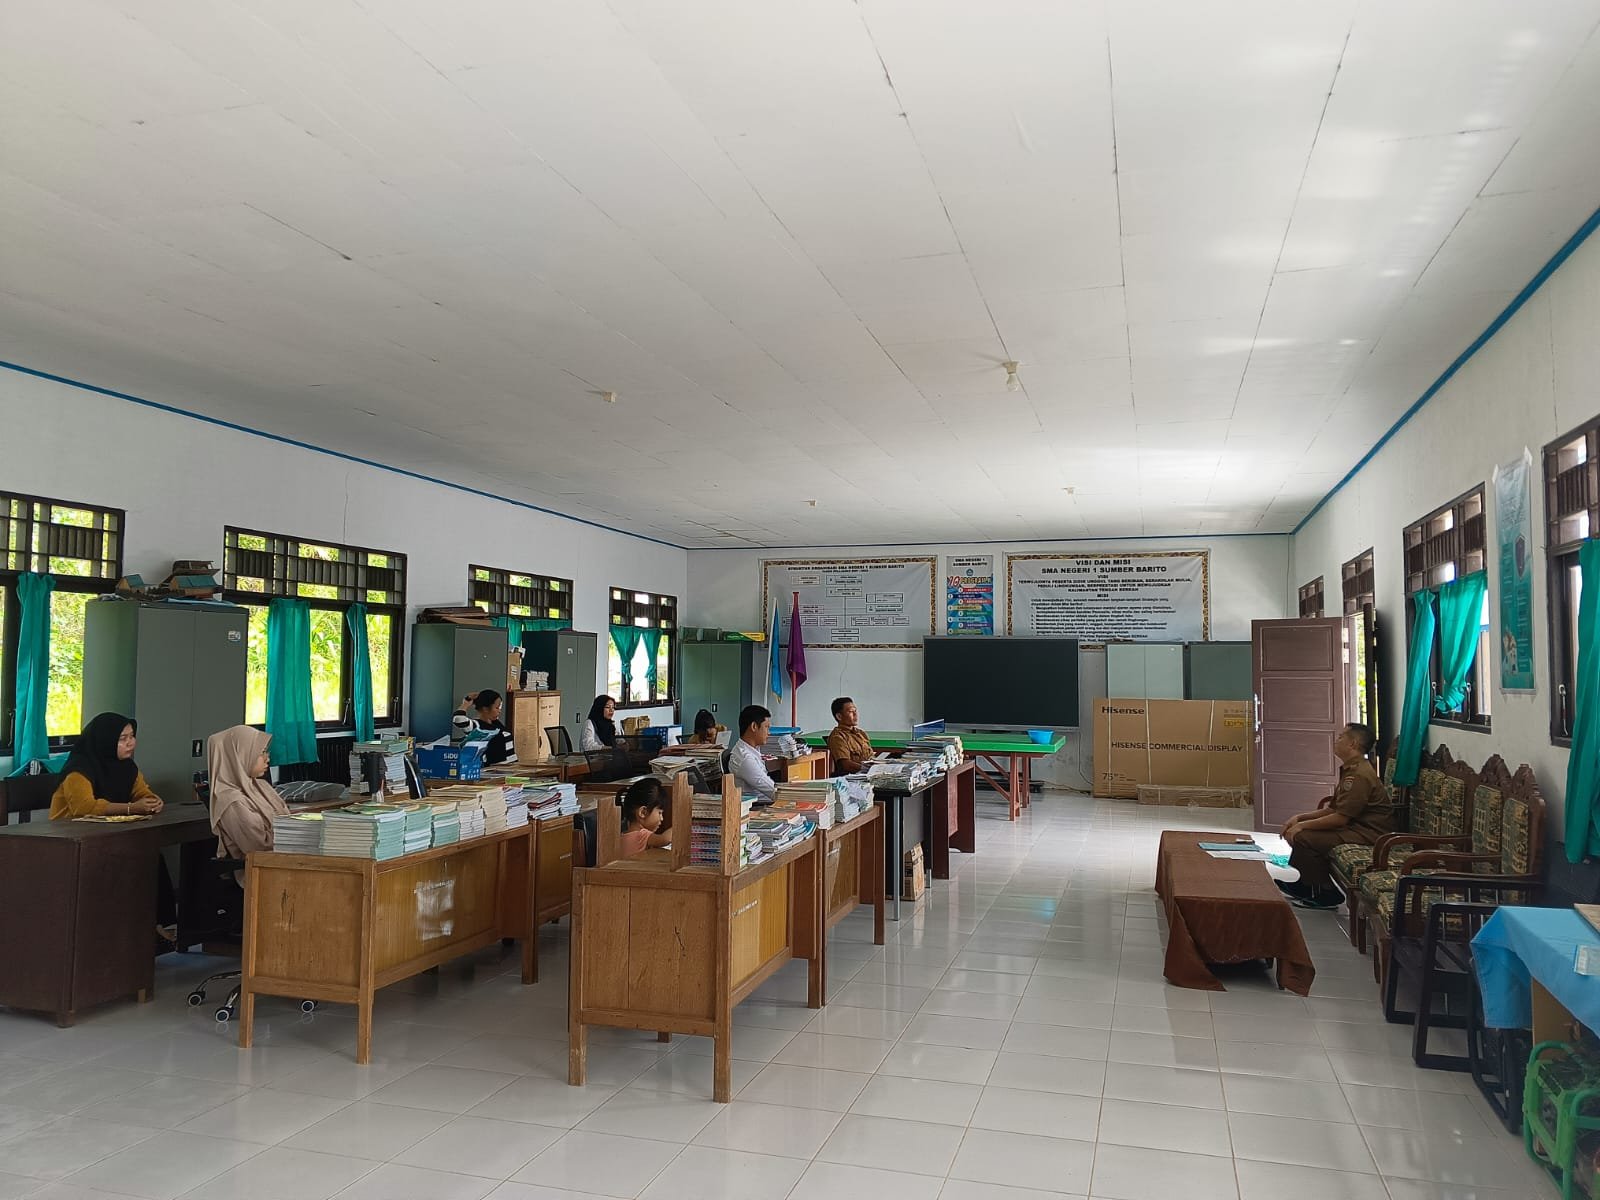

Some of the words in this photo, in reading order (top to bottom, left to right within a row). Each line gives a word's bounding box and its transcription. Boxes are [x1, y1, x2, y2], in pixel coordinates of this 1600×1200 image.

[1102, 706, 1145, 715] Hisense
[1111, 742, 1147, 750] HISENSE
[1148, 743, 1205, 751] COMMERCIAL
[1207, 744, 1244, 752] DISPLAY
